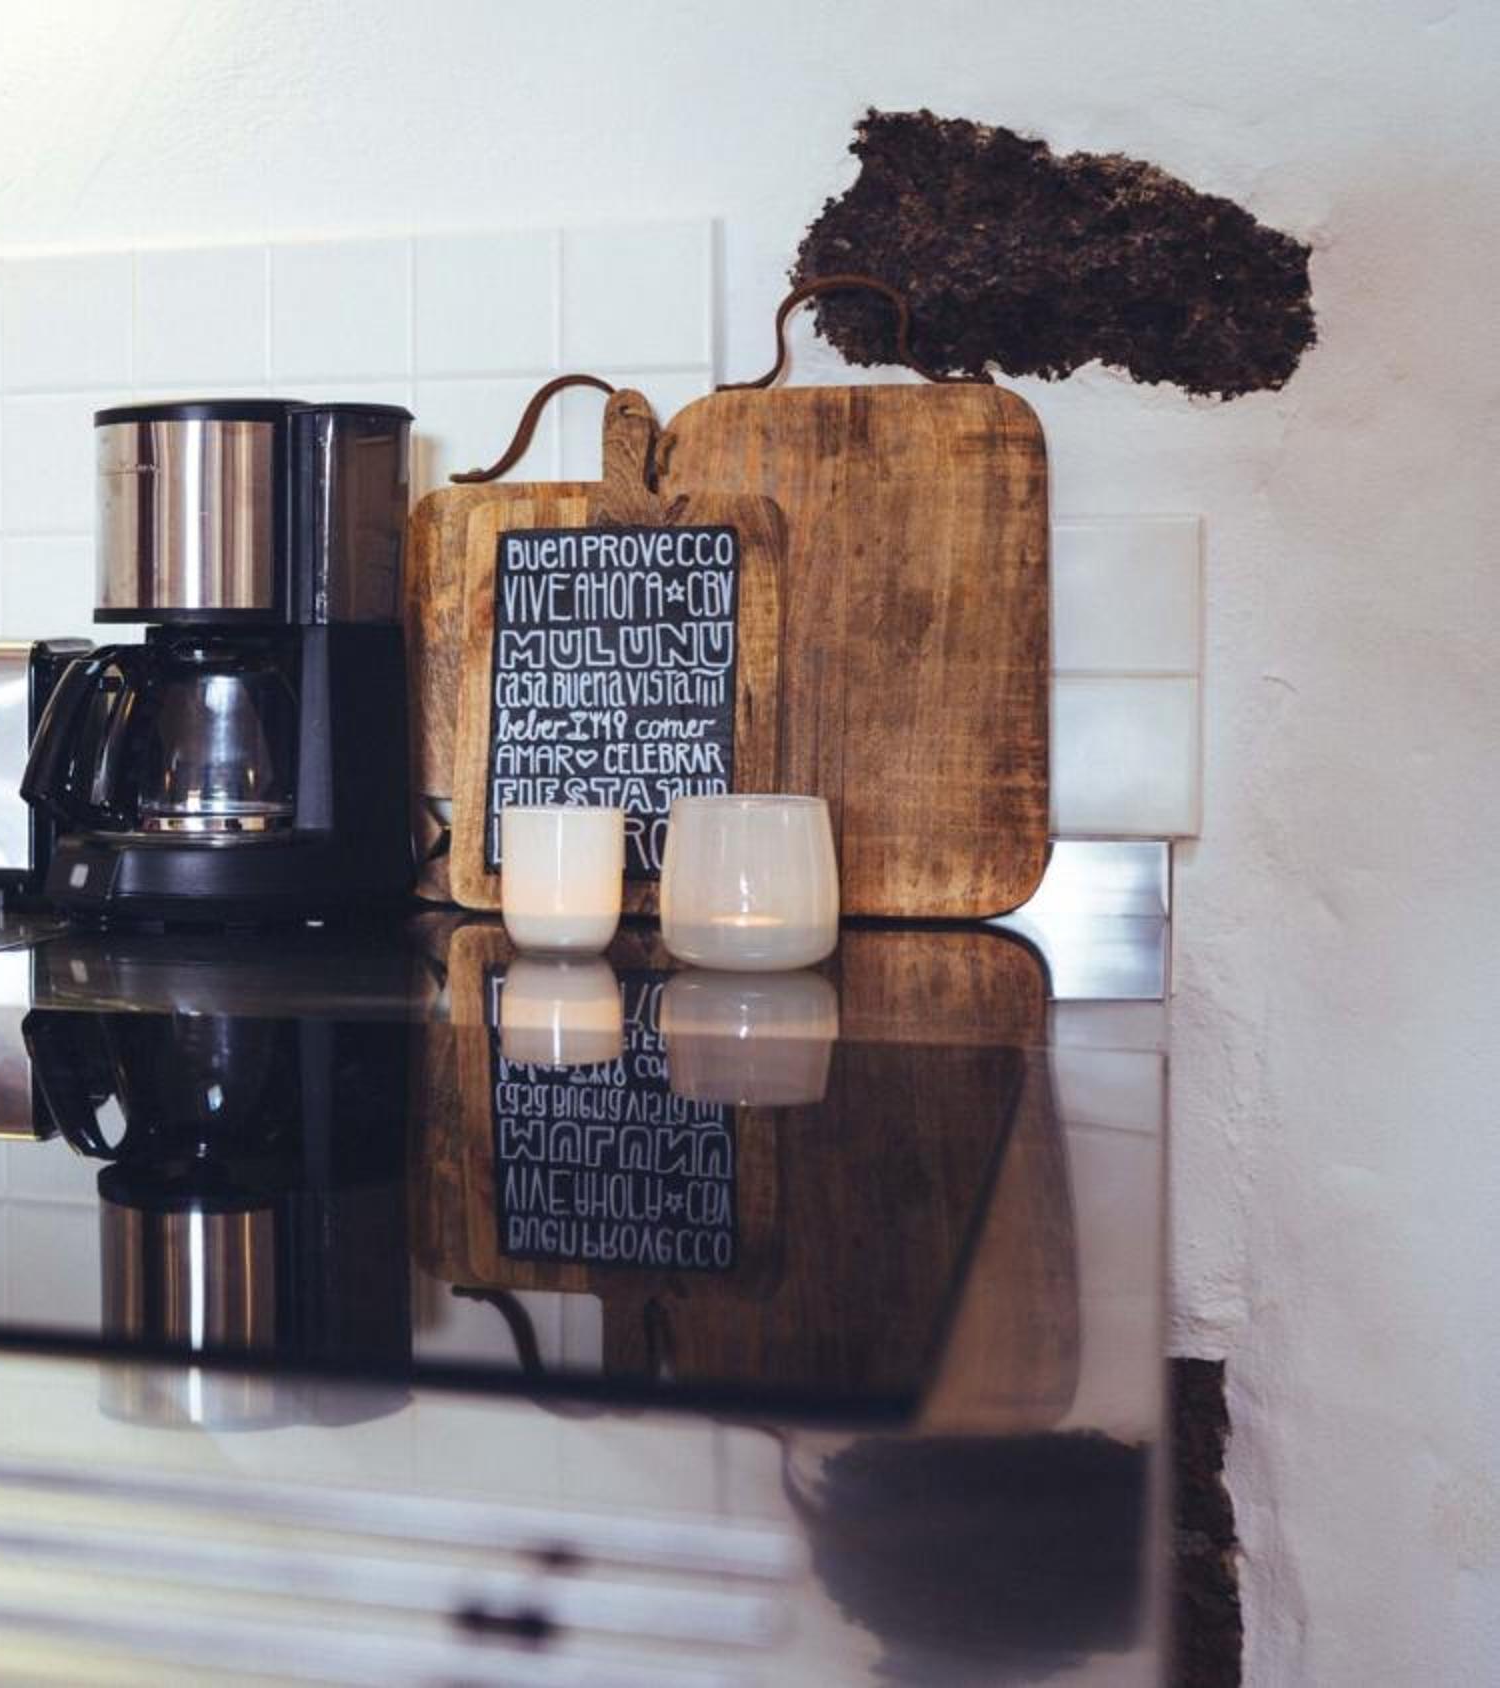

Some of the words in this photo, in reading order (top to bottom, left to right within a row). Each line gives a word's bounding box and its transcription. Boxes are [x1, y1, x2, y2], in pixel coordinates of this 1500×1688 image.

[503, 573, 572, 623] VIVE
[686, 570, 735, 617] CBV
[499, 621, 735, 670] MULUNU
[498, 708, 569, 741] beber
[635, 718, 716, 739] comer
[495, 744, 576, 775] AMAR
[603, 742, 726, 775] CELEBRAR
